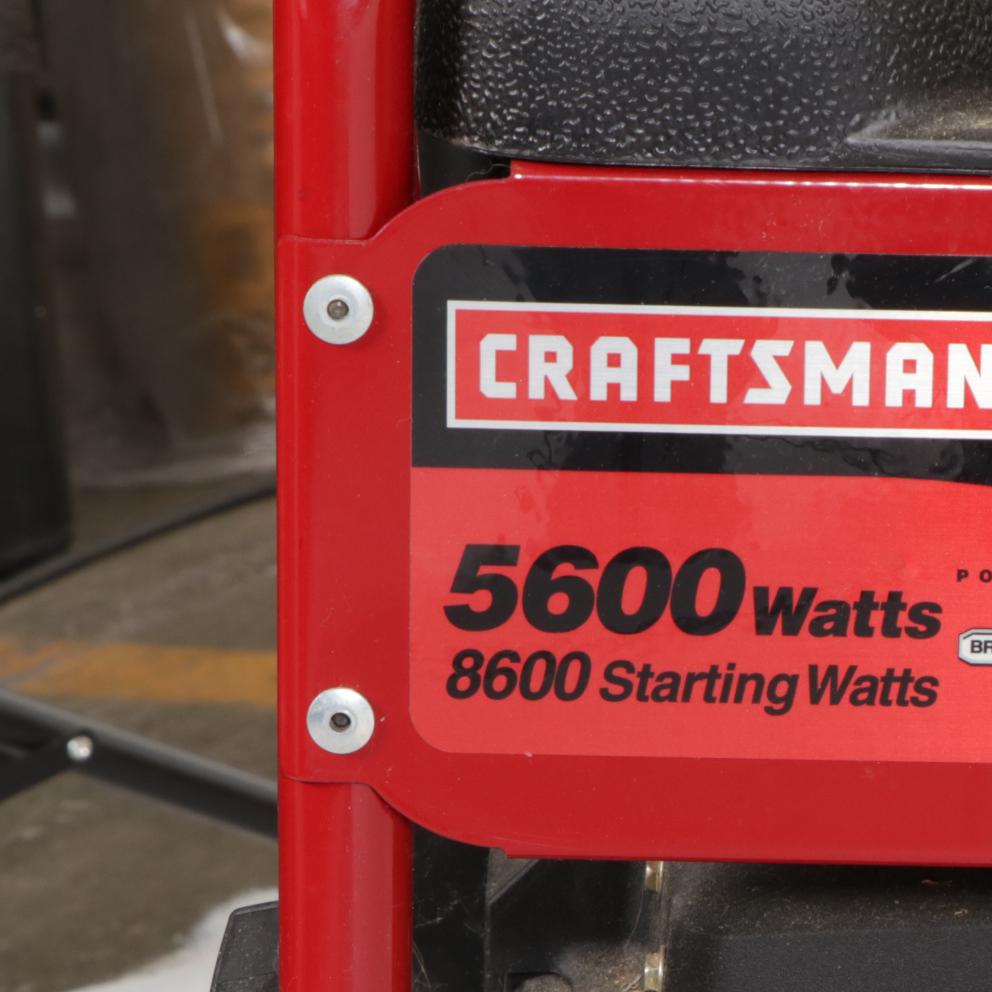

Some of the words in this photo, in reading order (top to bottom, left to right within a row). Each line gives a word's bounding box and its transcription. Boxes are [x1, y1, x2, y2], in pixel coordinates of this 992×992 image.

[442, 543, 746, 636] 5600
[753, 585, 943, 640] Watts
[445, 648, 592, 701] 8600
[599, 659, 800, 716] Starting
[807, 663, 939, 708] Watts
